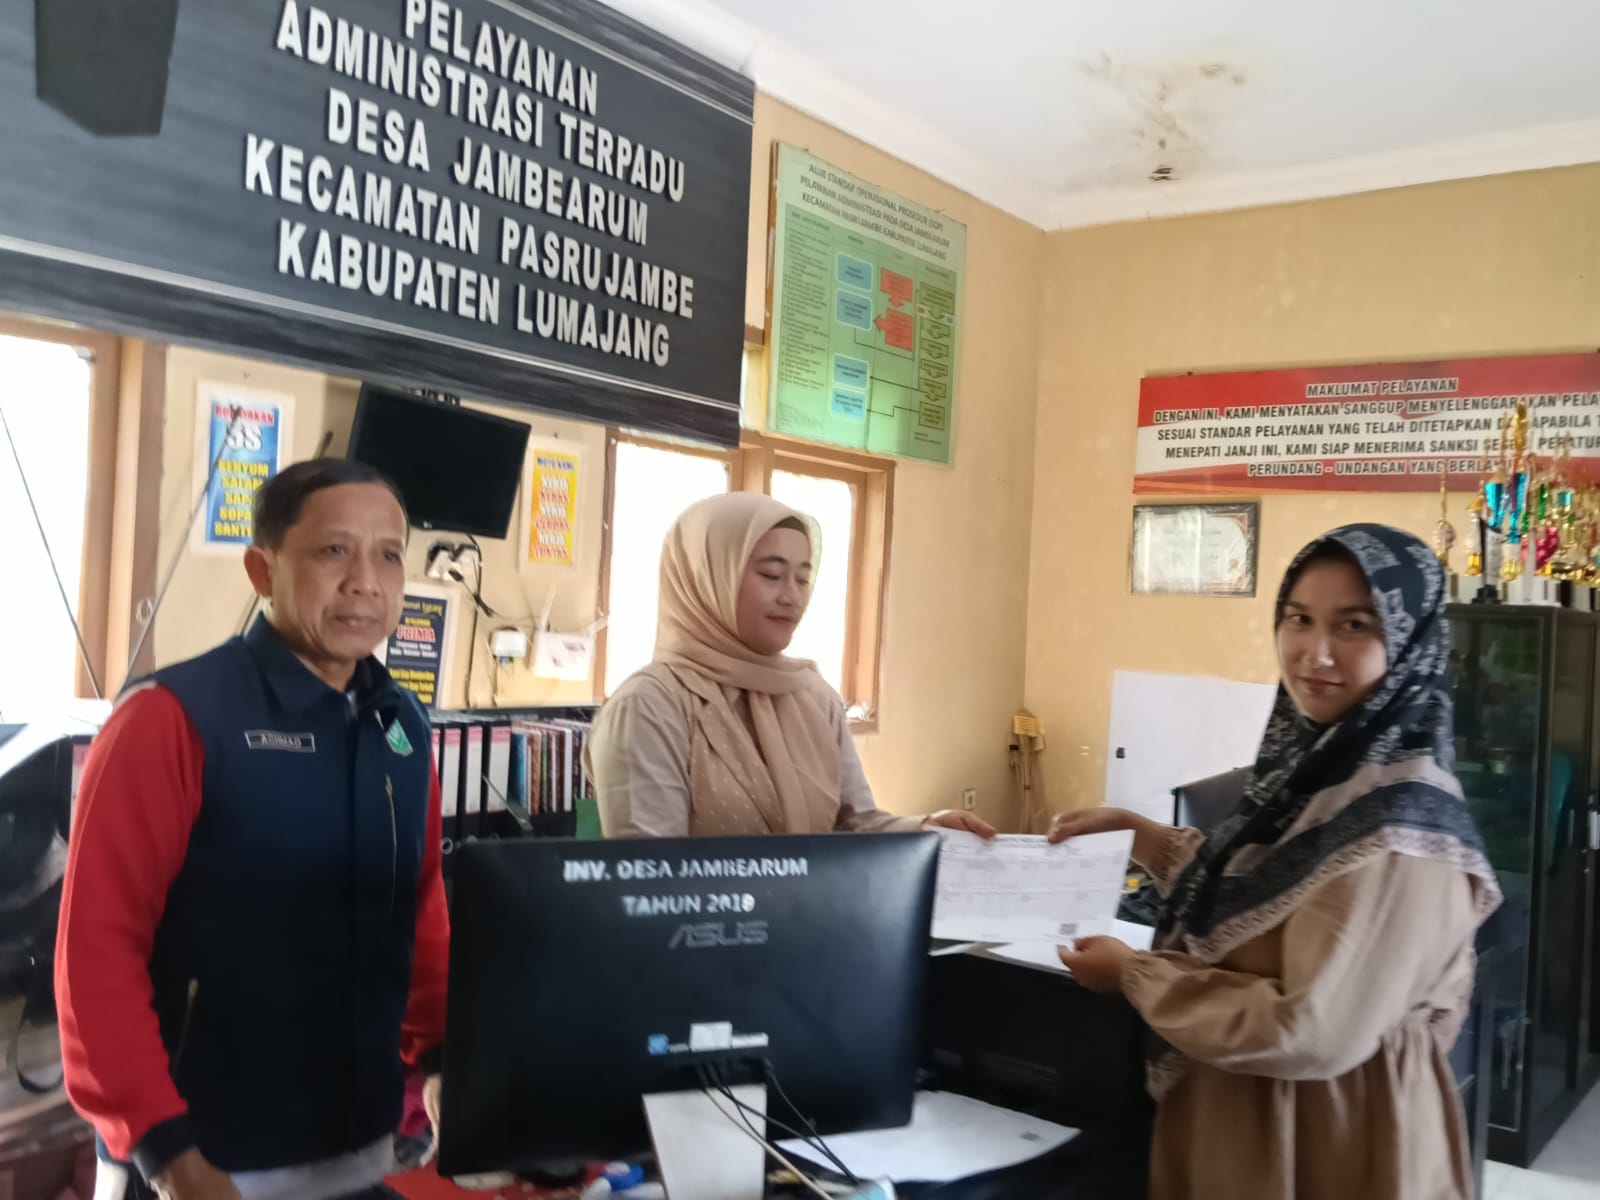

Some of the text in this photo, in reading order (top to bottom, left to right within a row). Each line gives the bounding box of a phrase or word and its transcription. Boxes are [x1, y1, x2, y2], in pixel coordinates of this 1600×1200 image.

[404, 0, 598, 116] PELAYANAN
[276, 0, 685, 202] ADMINISTRASI TERPADU
[328, 87, 649, 246] DESA JAMBEARUM
[245, 133, 480, 255] KECAMATAN
[501, 217, 694, 319] PASRUJAMBE
[277, 217, 500, 325] KABUPATEN
[516, 284, 670, 367] LUMAJANG
[1307, 379, 1457, 397] MAKLUMAT PELAYANAN
[1154, 409, 1199, 423] DENGAN
[1202, 408, 1222, 422] INI,
[1225, 406, 1256, 420] KAMI
[1259, 403, 1340, 419] MENYATAKAN
[1343, 401, 1404, 416] SANGGUP
[1562, 393, 1600, 408] PELA
[1157, 427, 1197, 441] SESUAI
[1199, 425, 1251, 440] STANDAR
[1255, 423, 1324, 438] PELAYANAN
[1328, 421, 1361, 435] YANG
[1365, 421, 1405, 434] TELAH
[1409, 417, 1492, 433] DITETAPKAN
[1165, 445, 1221, 459] MENEPATI
[1224, 444, 1258, 458] JANJI
[1261, 444, 1282, 458] INI,
[1285, 442, 1317, 456] KAMI
[1321, 441, 1350, 455] SIAP
[1353, 440, 1425, 455] MENERIMA
[1429, 438, 1479, 453] SANKSI
[1248, 461, 1323, 476] PERUNDANG
[1335, 460, 1405, 475] UNDANGAN
[1410, 459, 1448, 473] YANG
[563, 858, 612, 882] INV.
[616, 858, 673, 880] DESA
[622, 895, 701, 916] TAHUN
[669, 921, 768, 949] ASUS
